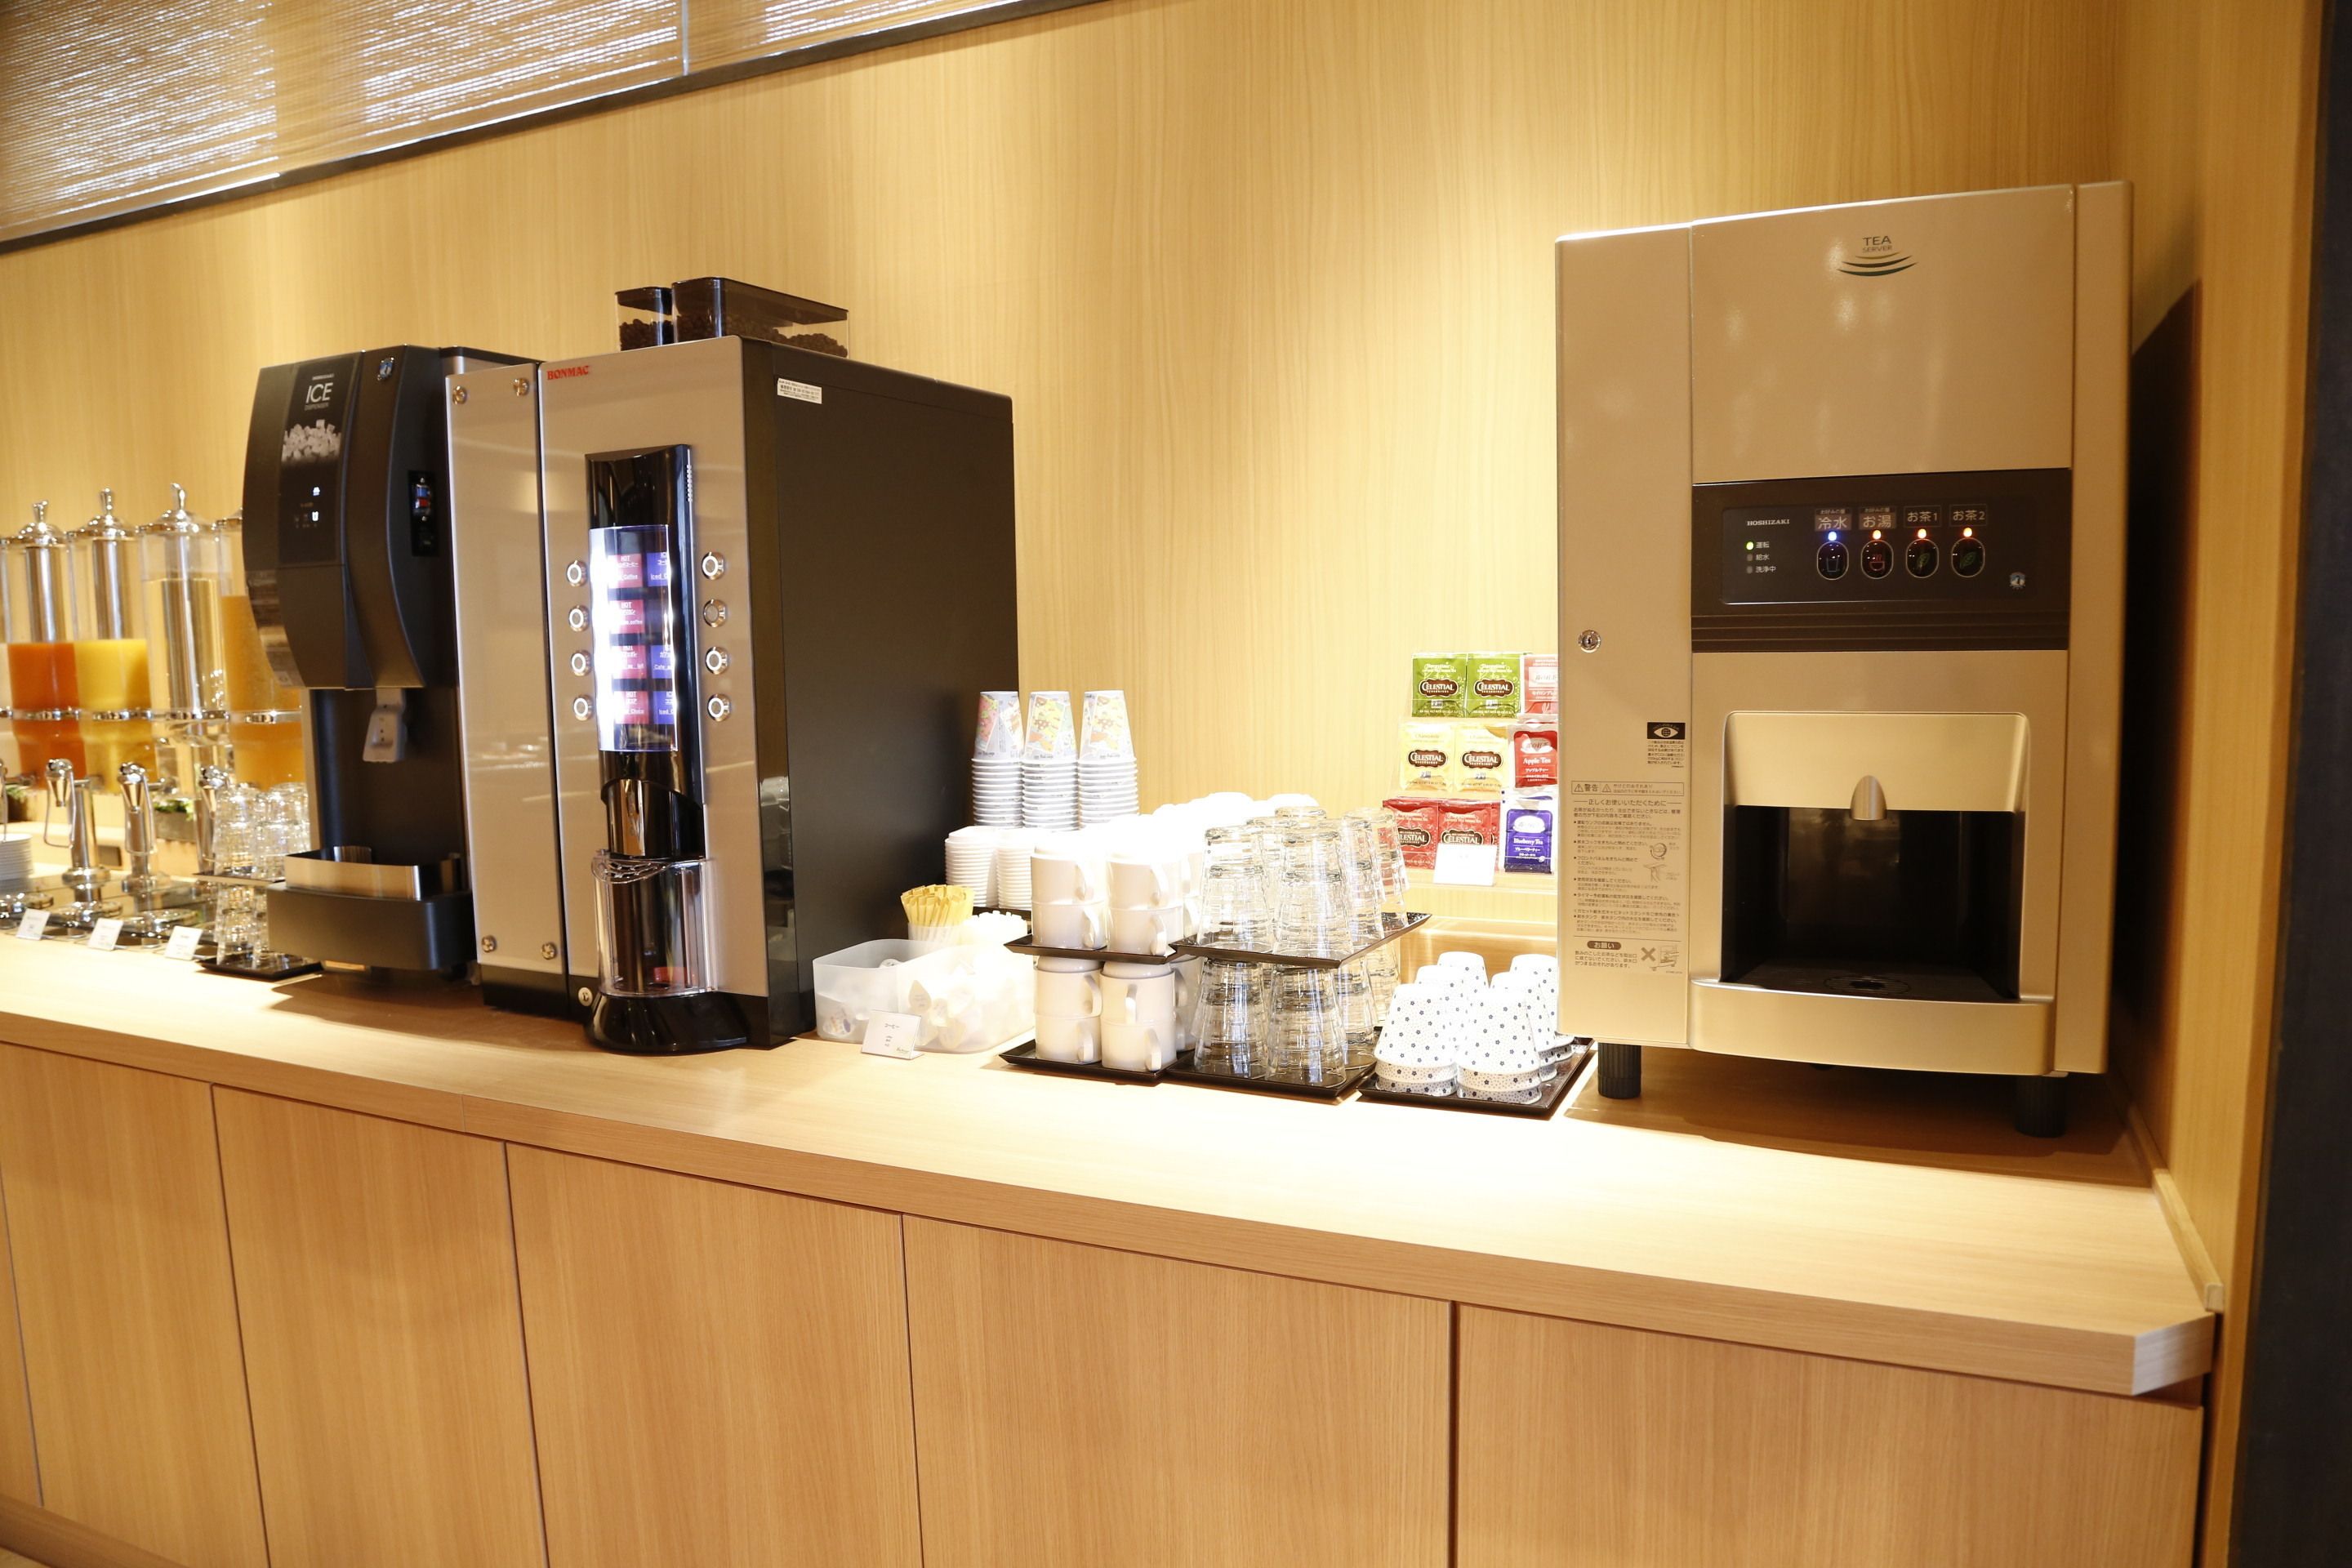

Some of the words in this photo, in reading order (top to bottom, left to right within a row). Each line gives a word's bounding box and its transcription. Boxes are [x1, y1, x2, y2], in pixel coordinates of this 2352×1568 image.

[1862, 235, 1892, 246] TEA
[1862, 245, 1892, 253] SERVER
[547, 365, 590, 381] BONMAC
[305, 382, 334, 403] ICE
[1907, 511, 1938, 523] お茶1
[1953, 510, 1986, 521] お茶2
[1818, 516, 1847, 530] 冷水
[1863, 514, 1891, 528] お湯
[1422, 682, 1454, 691] CELESTIAL
[1477, 682, 1510, 692] CELESTIAL
[1410, 753, 1444, 762] CELESTIAL
[1464, 754, 1499, 764] CELESTIAL
[1523, 758, 1540, 766] Apple
[1588, 799, 1667, 807] 正しくお使いいただくために
[1444, 833, 1480, 844] CELESTIAL
[1513, 838, 1535, 846] Blueberry
